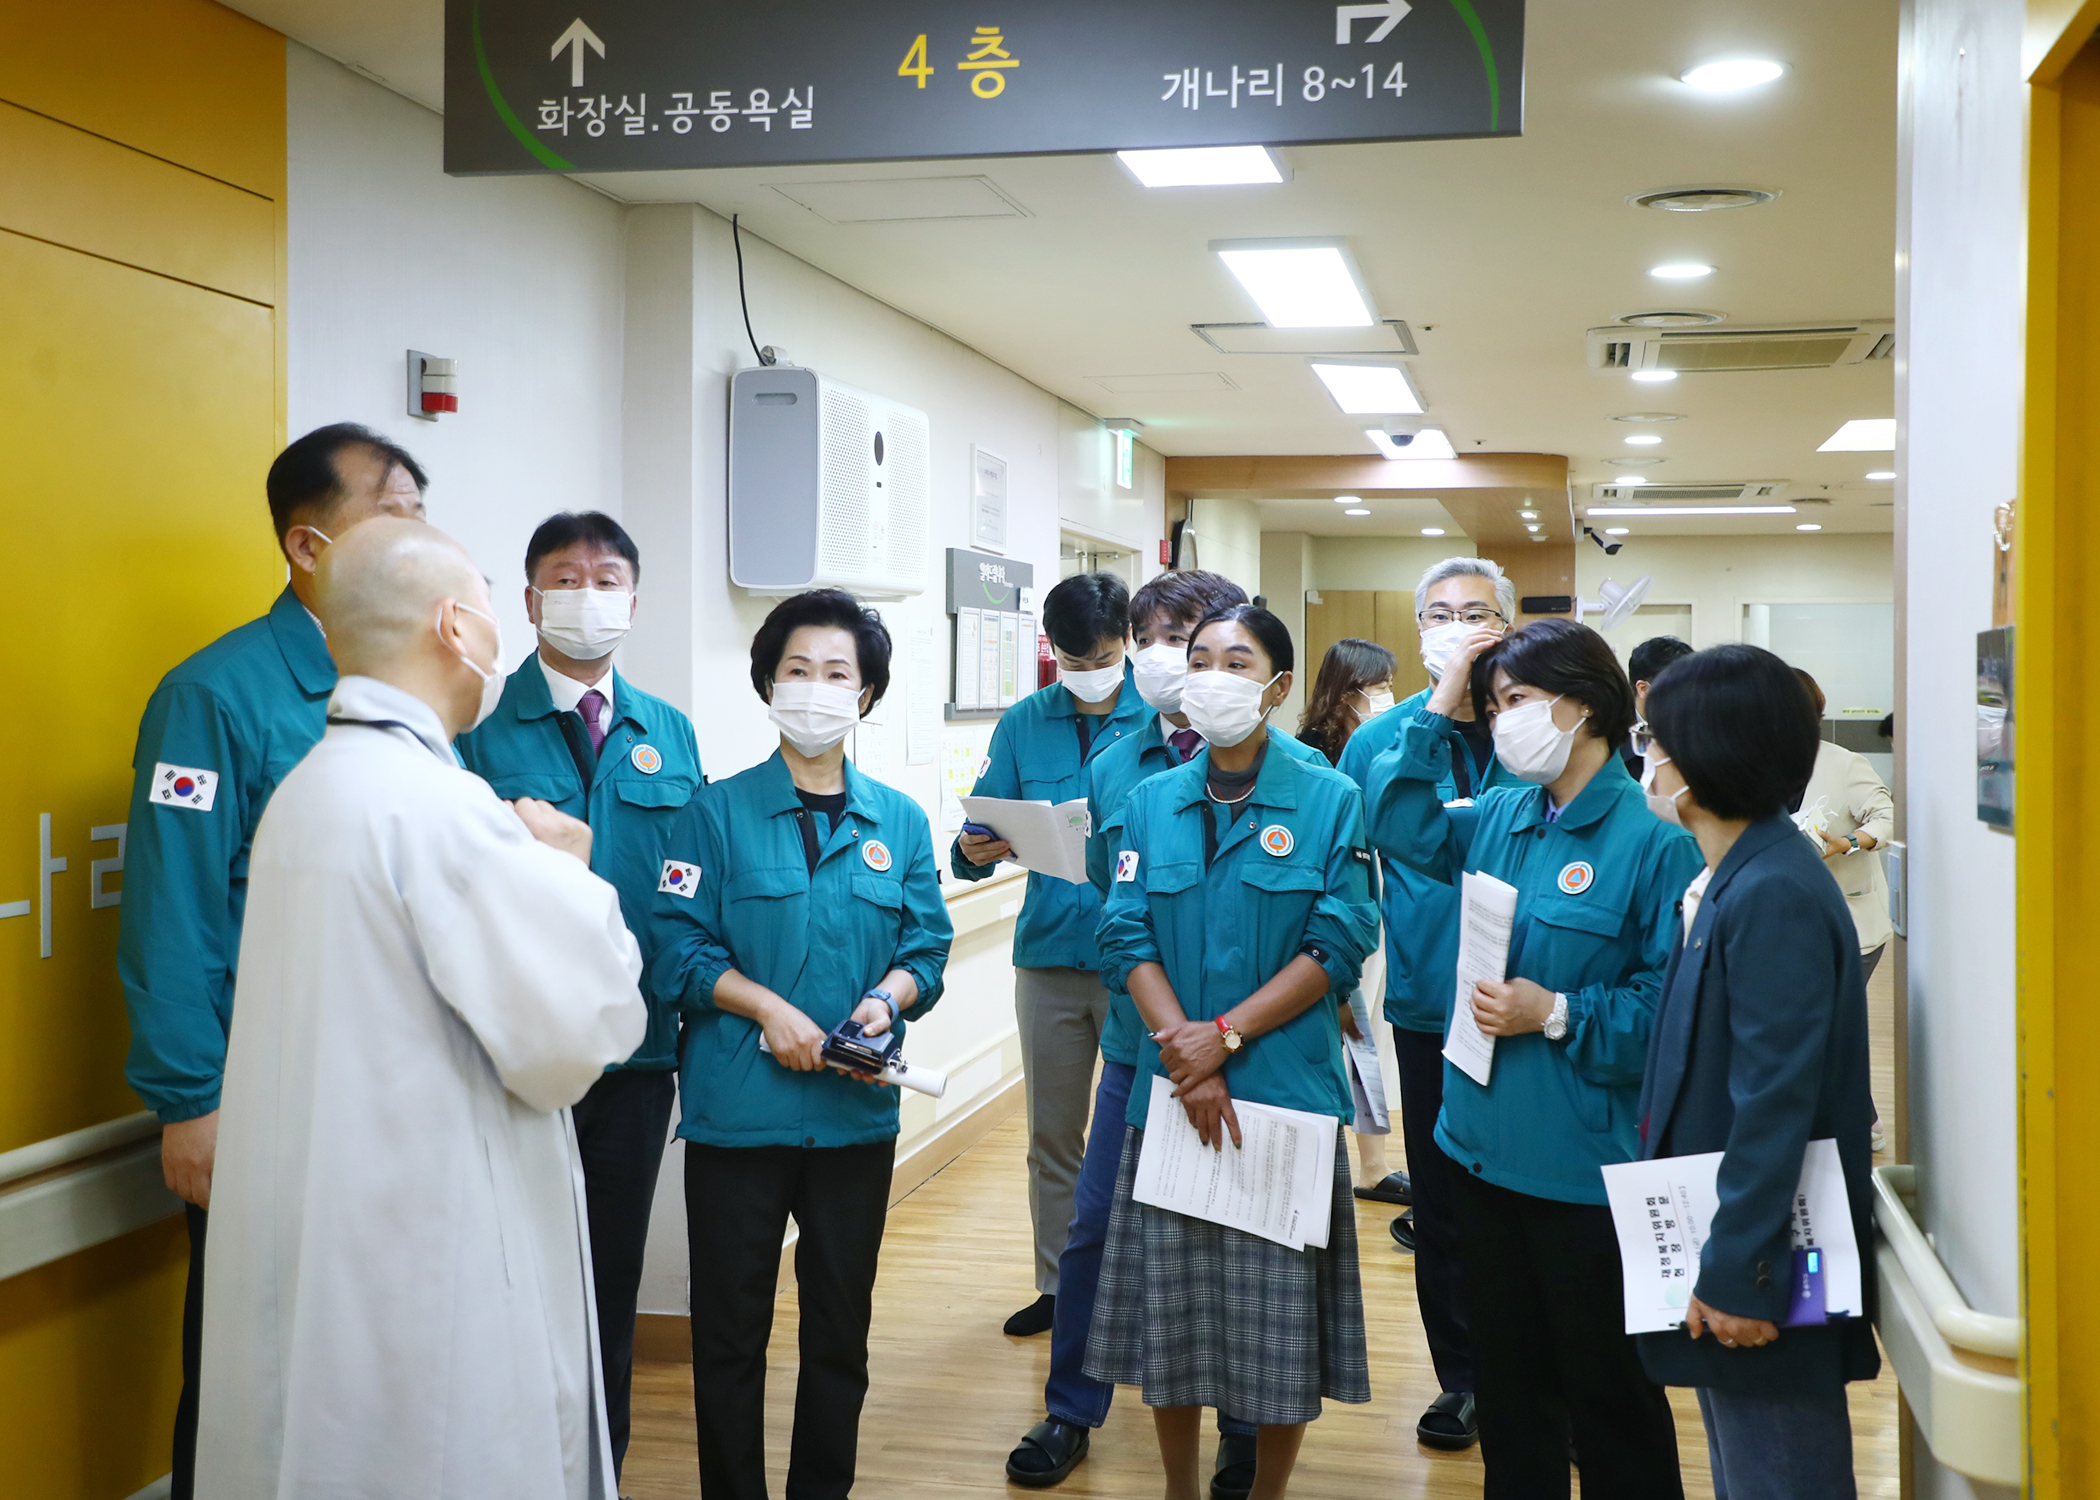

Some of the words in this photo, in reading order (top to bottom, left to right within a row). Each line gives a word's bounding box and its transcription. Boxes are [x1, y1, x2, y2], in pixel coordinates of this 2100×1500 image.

[897, 34, 934, 90] 4
[957, 26, 1020, 100] 층
[1161, 62, 1284, 111] 개나리
[1302, 62, 1409, 102] 8~14
[537, 86, 815, 137] 화장실.공동욕실
[1645, 1197, 1671, 1278] 재정복지위원회
